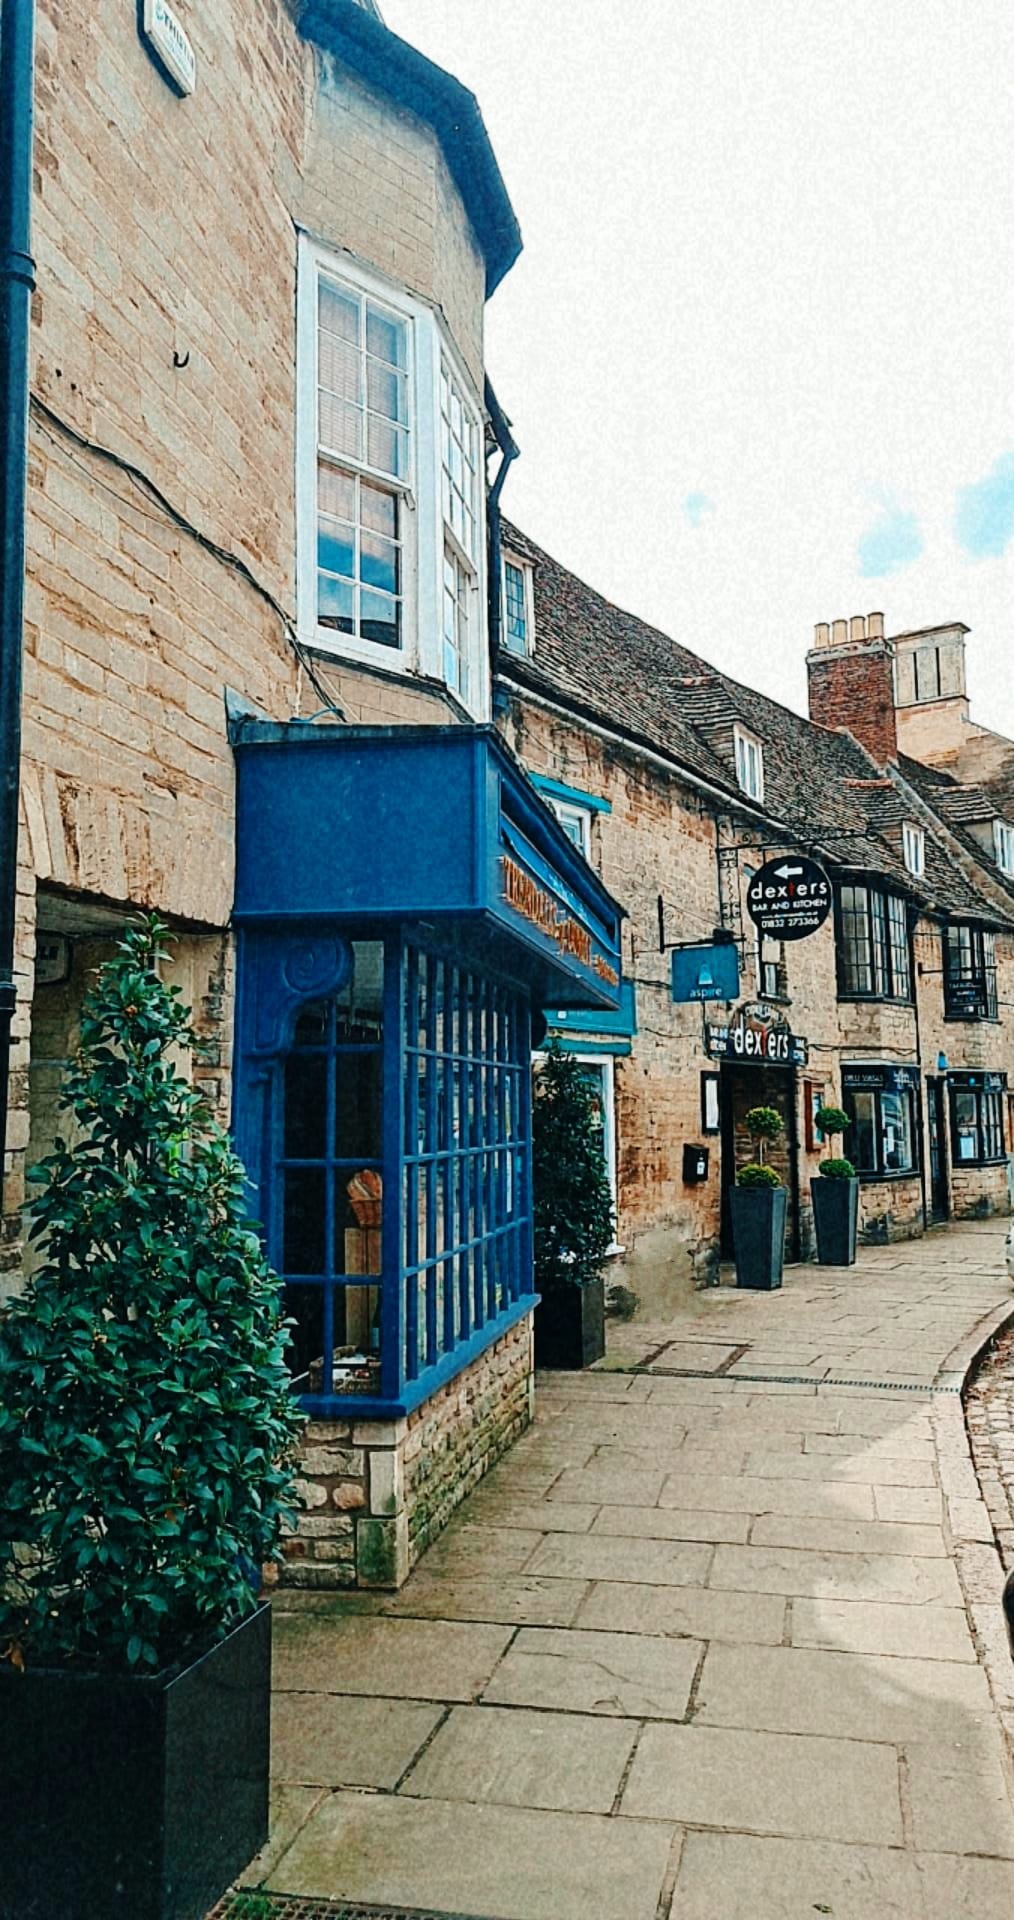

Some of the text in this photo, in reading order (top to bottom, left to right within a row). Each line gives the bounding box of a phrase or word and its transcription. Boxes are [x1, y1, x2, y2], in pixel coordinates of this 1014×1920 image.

[751, 881, 828, 900] dexters
[752, 898, 827, 912] BAR AND KITCHEN
[761, 917, 819, 928] 01832 273366
[689, 986, 722, 999] aspire
[734, 1014, 789, 1058] dexters
